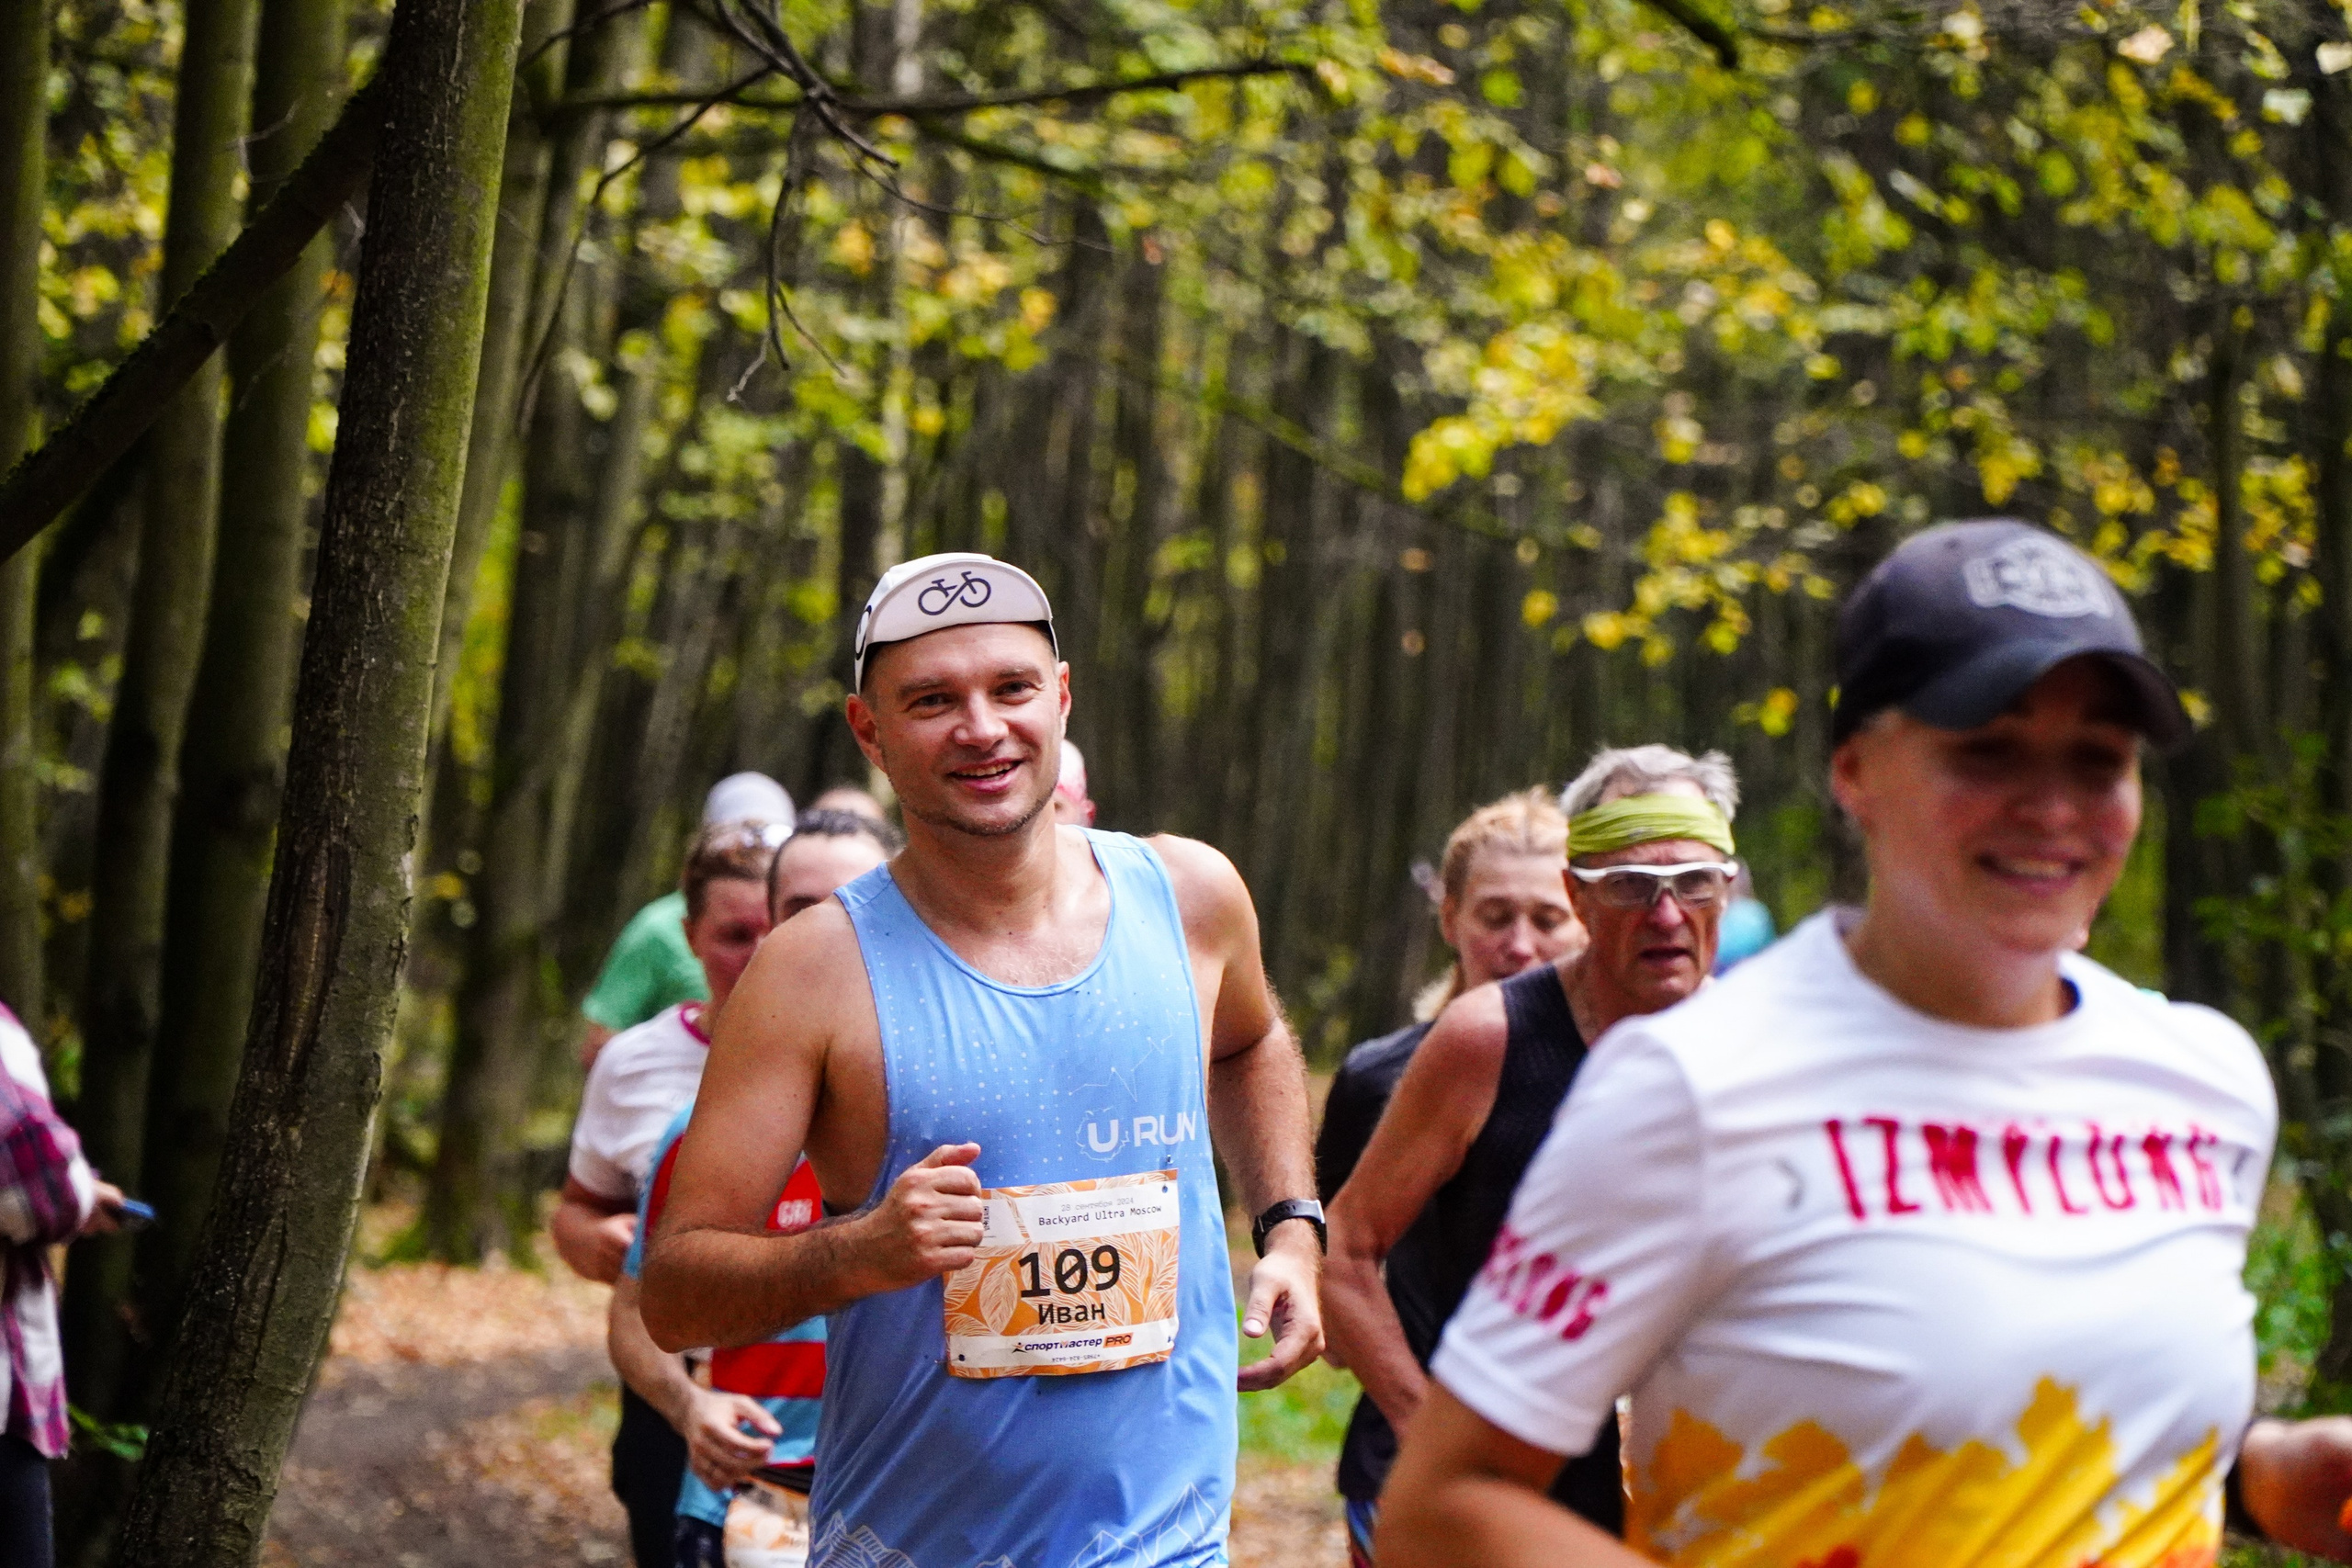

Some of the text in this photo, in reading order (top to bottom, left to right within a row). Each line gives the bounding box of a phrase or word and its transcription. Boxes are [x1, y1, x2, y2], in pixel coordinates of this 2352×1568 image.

[1087, 1111, 1196, 1153] U RUN
[1038, 1205, 1162, 1226] Backyard Ultra Moscow
[1018, 1245, 1120, 1298] 109
[1039, 1303, 1105, 1325] Иван
[1105, 1335, 1131, 1346] PRO
